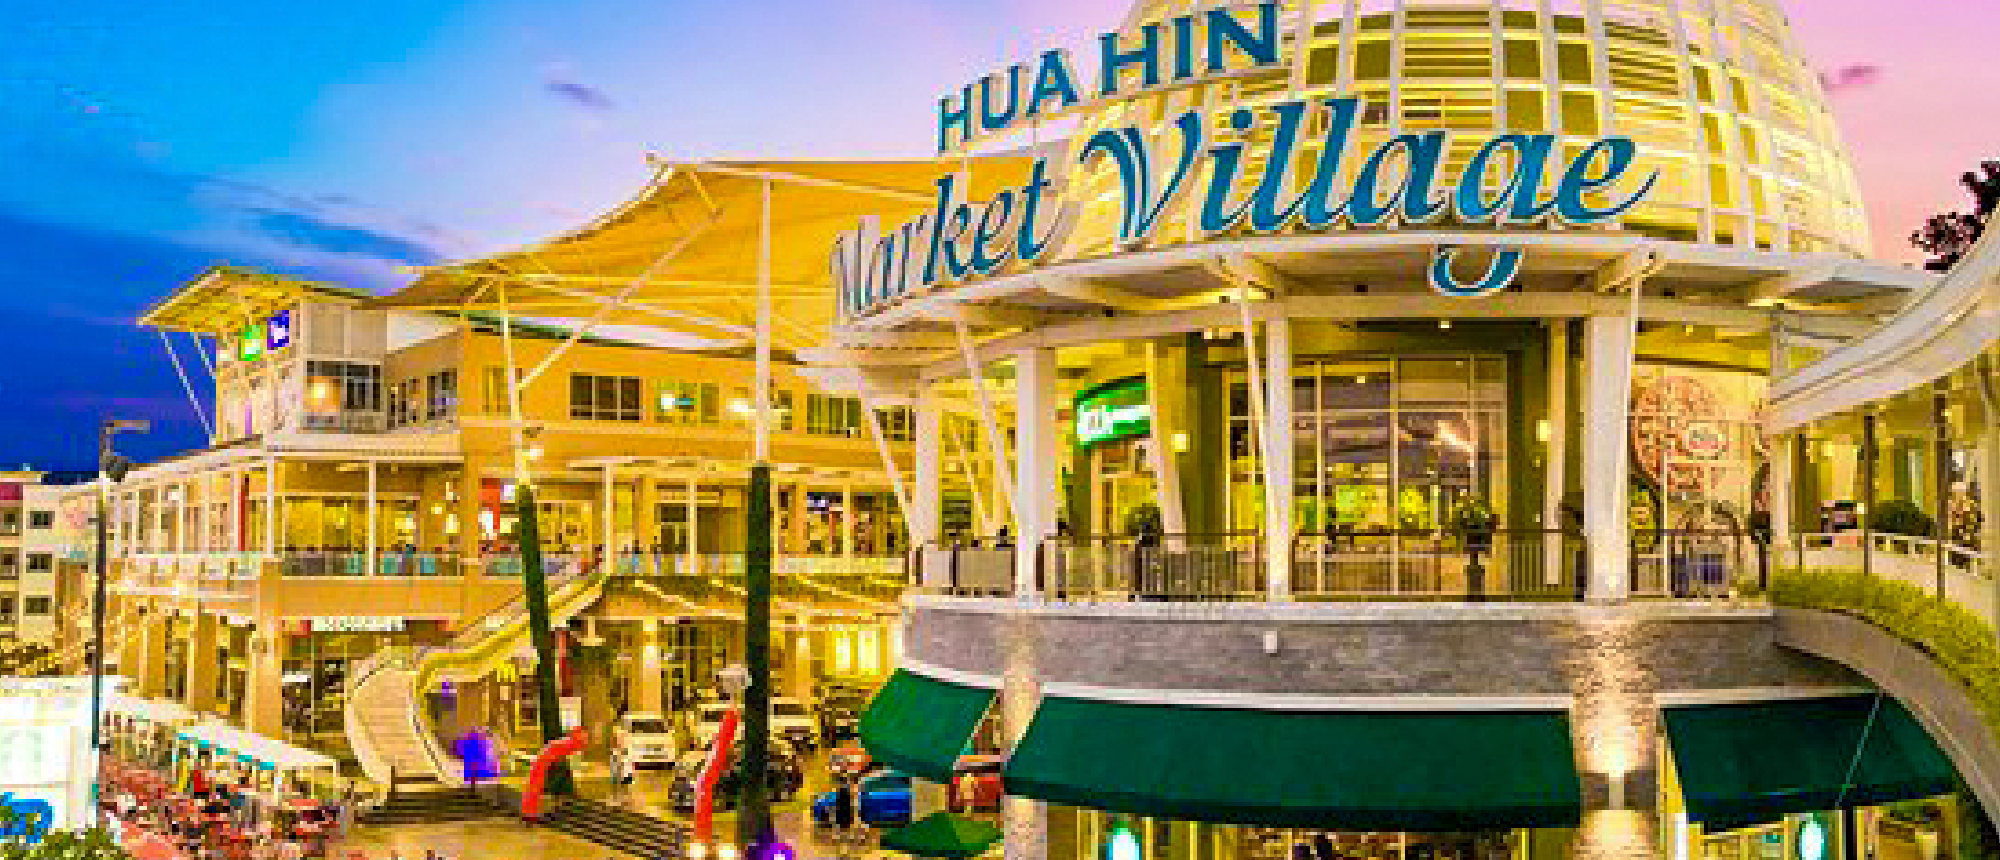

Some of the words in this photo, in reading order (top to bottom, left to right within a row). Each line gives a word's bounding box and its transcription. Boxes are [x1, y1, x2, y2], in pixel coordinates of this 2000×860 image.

[937, 48, 1078, 151] HUA
[1098, 2, 1279, 96] HIN
[830, 156, 1061, 315] Market
[1080, 97, 1659, 297] Village
